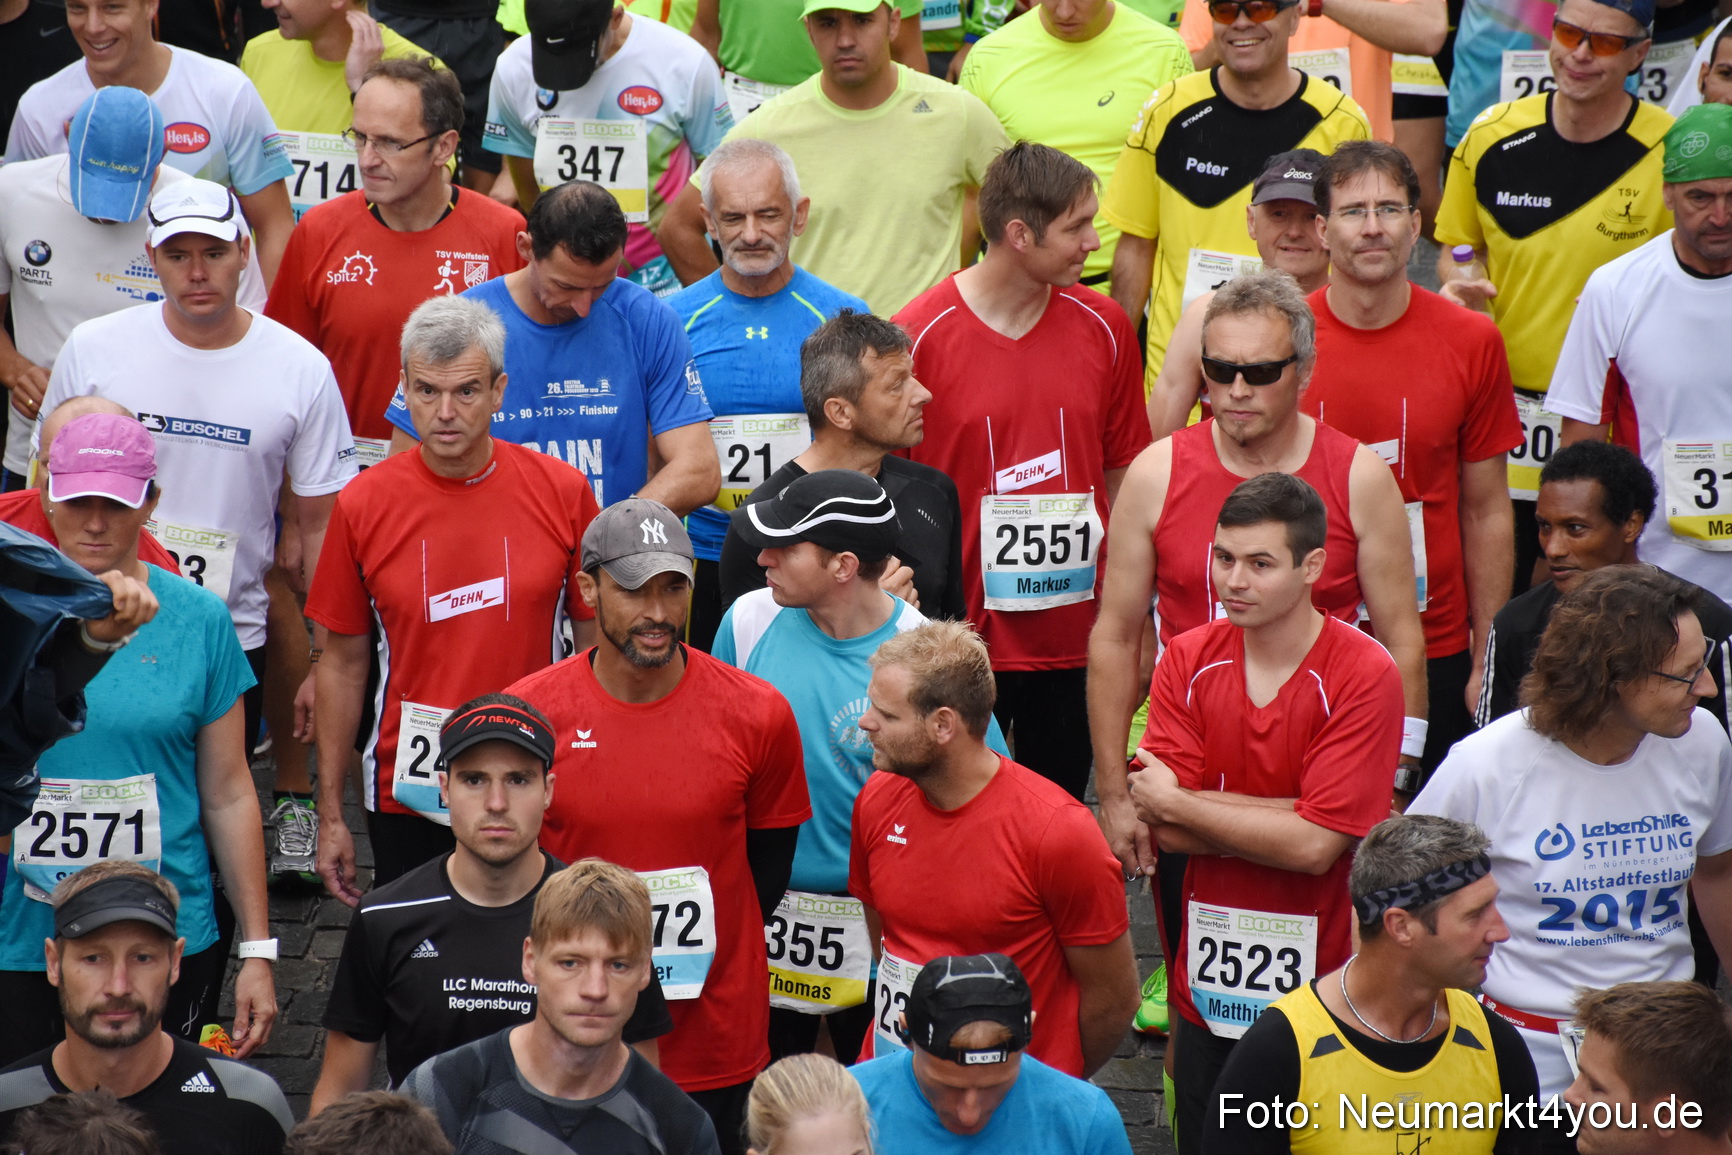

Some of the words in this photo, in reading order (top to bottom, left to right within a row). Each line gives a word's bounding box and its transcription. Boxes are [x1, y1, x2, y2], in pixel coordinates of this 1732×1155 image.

[624, 93, 658, 109] Hervis
[1182, 106, 1213, 128] STANNO
[167, 130, 206, 146] Hervis
[484, 121, 508, 137] CK
[583, 123, 636, 136] BOCK
[1502, 132, 1537, 150] STANNO
[109, 161, 140, 174] happy
[558, 144, 625, 182] 347
[1186, 156, 1230, 177] Peter
[1496, 191, 1551, 208] Markus
[1618, 188, 1641, 198] TSV
[1596, 222, 1649, 241] Burgthann
[435, 250, 452, 259] TSV
[453, 251, 489, 261] Wolfstein
[20, 267, 53, 280] PARTL
[638, 265, 661, 284] 17.
[1197, 262, 1234, 273] NeuerMarkt
[326, 270, 358, 285] Spitz
[520, 408, 532, 419] 90
[543, 407, 554, 417] 21
[579, 405, 618, 416] Finisher
[171, 420, 246, 442] BÜSCHEL
[742, 419, 800, 433] BOCK
[78, 447, 124, 457] BROOKS
[727, 443, 771, 482] 21
[1015, 463, 1045, 483] DEHN
[992, 508, 1032, 516] NeuerMarkt
[1038, 498, 1088, 513] BOCK
[996, 521, 1091, 566] 2551
[1017, 577, 1071, 594] Markus
[450, 590, 484, 609] DEHN
[571, 740, 597, 749] erima
[81, 781, 146, 800] BOCK
[30, 808, 144, 859] 2571
[1583, 831, 1693, 860] STIFTUNG
[20, 854, 26, 862] A
[1604, 855, 1670, 869] Nürnberger
[1675, 850, 1694, 861] Land
[642, 872, 697, 892] OCK
[1534, 882, 1557, 893] 17.
[1563, 862, 1694, 893] Altstadtfestlauf
[798, 896, 862, 916] BOCK
[1538, 884, 1684, 932] 2015
[651, 900, 703, 948] 72
[1196, 917, 1231, 931] NeuerMarkt
[1238, 914, 1304, 936] BOCK
[1536, 920, 1685, 947] www.lebenshilfe-nbg-land.de
[764, 915, 845, 971] 355
[1197, 936, 1302, 995] 2523
[443, 979, 466, 991] LLC
[470, 978, 538, 994] Marathon
[769, 971, 832, 1000] Thomas
[448, 997, 531, 1014] Regensburg
[1504, 1014, 1526, 1027] balance
[181, 1085, 215, 1093] adidas
